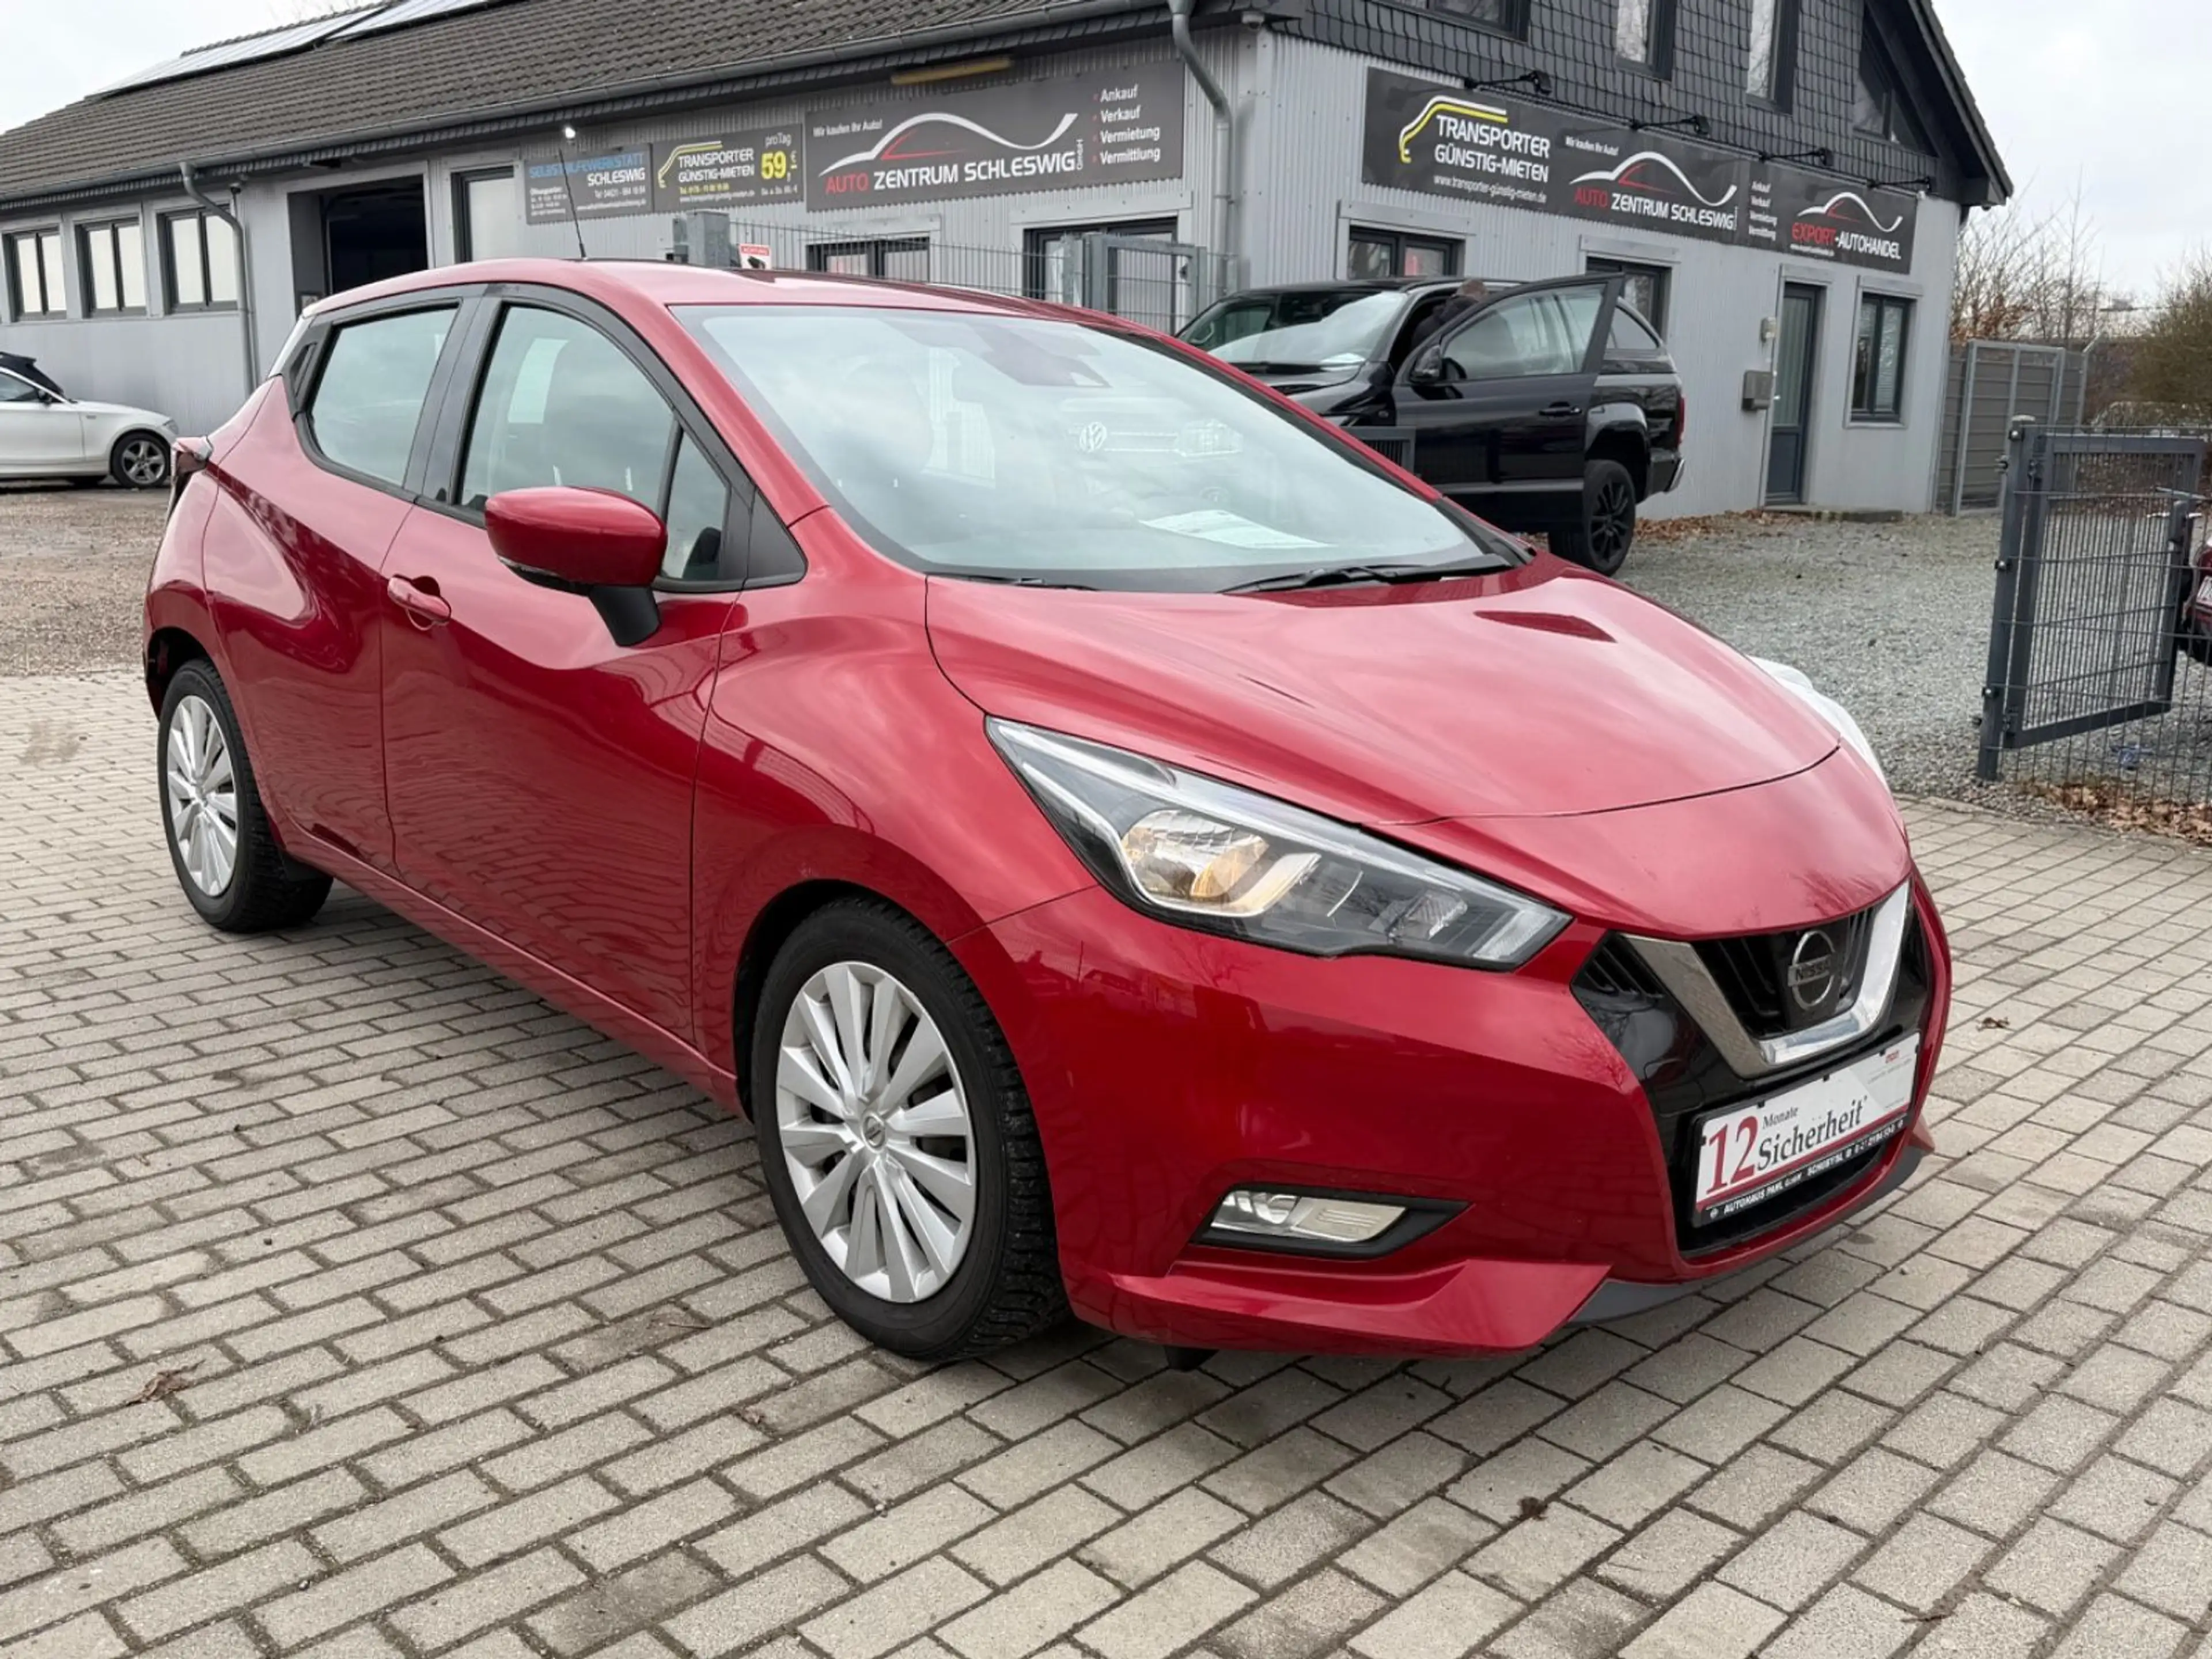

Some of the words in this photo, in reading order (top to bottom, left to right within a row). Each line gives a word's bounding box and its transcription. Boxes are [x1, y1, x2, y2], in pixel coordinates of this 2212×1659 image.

[1100, 85, 1139, 103] Ankauf
[1100, 105, 1142, 123] Verkauf
[1100, 126, 1161, 144] Vermietung
[1436, 115, 1551, 159] TRANSPORTER
[678, 148, 755, 168] TRANSPORTER
[1100, 147, 1161, 165] Vermittlung
[1434, 143, 1550, 183] GÜNSTIG-MIETEN
[587, 167, 646, 187] SCHLESWIG
[679, 164, 755, 183] GÜNSTIG-MIETEN
[825, 173, 869, 195] AUTO
[873, 164, 959, 191] ZENTRUM
[964, 151, 1075, 182] SCHLESWIG
[1574, 187, 1609, 208] AUTO
[1611, 192, 1669, 219] ZENTRUM
[1671, 204, 1734, 230] SCHLESWIG
[1706, 1115, 1759, 1195] 12
[1762, 1106, 1799, 1130] Monate
